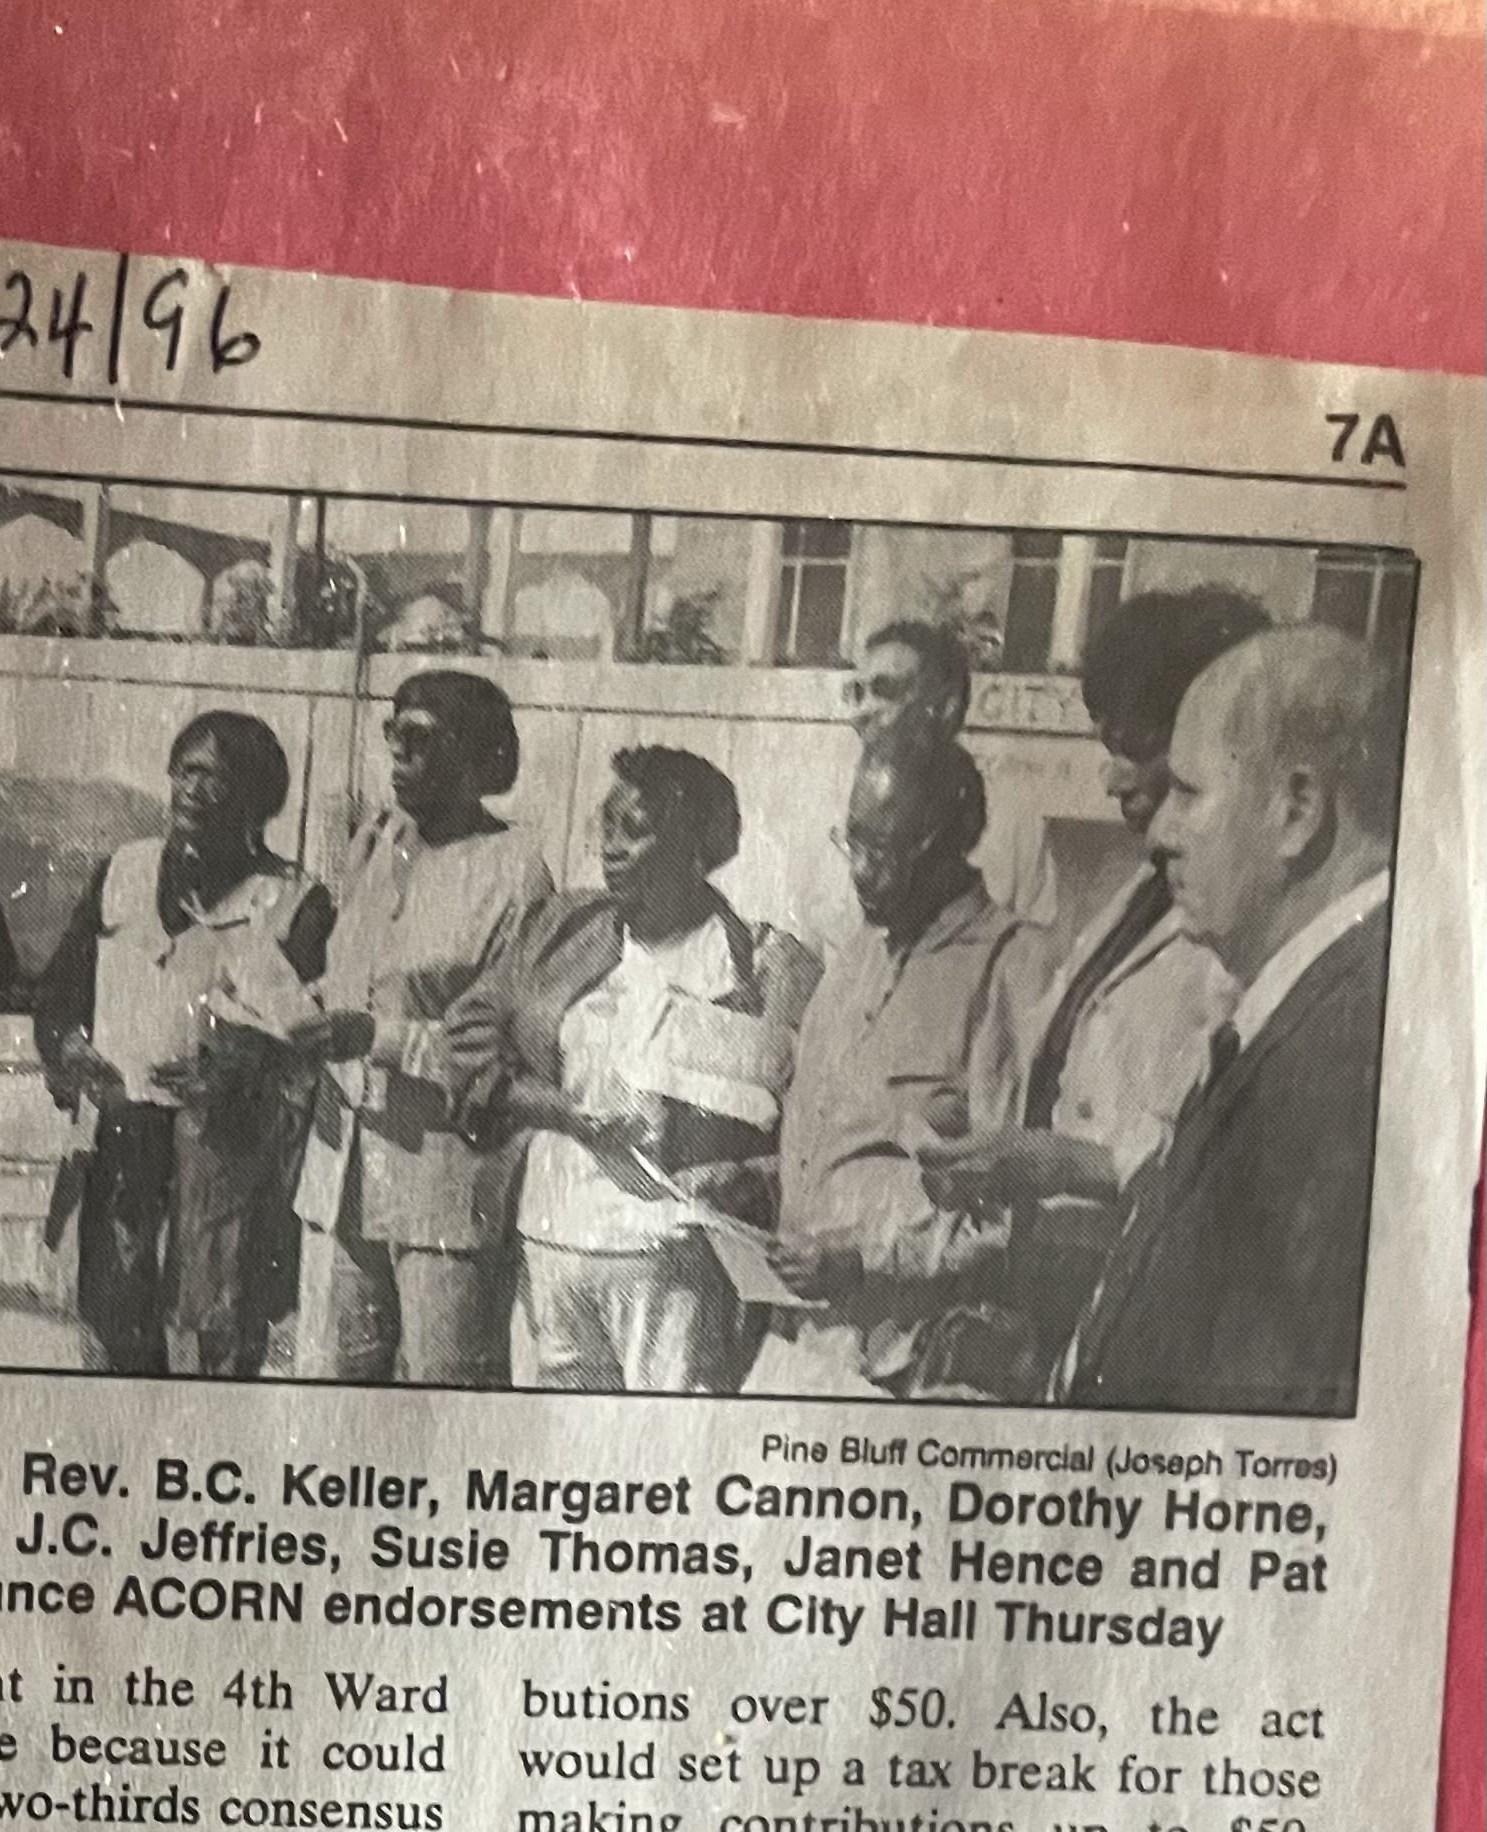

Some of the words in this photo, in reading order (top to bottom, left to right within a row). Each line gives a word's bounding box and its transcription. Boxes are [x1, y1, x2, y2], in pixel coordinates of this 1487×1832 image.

[1325, 412, 1408, 469] 7A
[762, 1433, 828, 1465] Pine
[840, 1435, 908, 1467] Bluff
[917, 1437, 1095, 1473] Commercial
[1105, 1444, 1223, 1482] (Joseph
[1234, 1449, 1337, 1486] Torres)
[23, 1451, 129, 1499] Rev.
[156, 1457, 256, 1506] B.C.
[283, 1462, 439, 1520] Keller,
[466, 1468, 691, 1525] Margaret
[715, 1473, 922, 1531] Cannon,
[948, 1479, 1143, 1541] Dorothy
[1165, 1488, 1327, 1544] Horne,
[16, 1511, 112, 1558] J.C.
[140, 1516, 341, 1576] Jeffries,
[370, 1524, 510, 1572] Susie
[539, 1529, 753, 1585] Thomas,
[783, 1534, 922, 1582] Janet
[950, 1538, 1103, 1588] Hence
[1130, 1547, 1221, 1592] and
[1249, 1549, 1327, 1594] Pat
[113, 1574, 303, 1624] ACORN
[324, 1586, 682, 1633] endorsements
[702, 1595, 748, 1634] at
[766, 1592, 865, 1648] City
[884, 1596, 977, 1642] Hall
[998, 1600, 1224, 1657] Thursday
[53, 1661, 95, 1706] in
[124, 1665, 195, 1710] the
[222, 1667, 293, 1712] 4th
[324, 1670, 449, 1715] Ward
[522, 1678, 690, 1723] butions
[730, 1693, 830, 1726] over
[869, 1684, 956, 1731] $50.
[994, 1690, 1108, 1744] Also,
[1150, 1694, 1220, 1737] the
[1260, 1705, 1325, 1741] act
[518, 1739, 655, 1781] would
[678, 1749, 742, 1784] set
[763, 1754, 821, 1798] up
[842, 1757, 866, 1788] a
[888, 1752, 952, 1790] tax
[972, 1748, 1097, 1794] break
[1118, 1752, 1183, 1796] for
[1203, 1755, 1321, 1800] those
[219, 1796, 443, 1832] consensus
